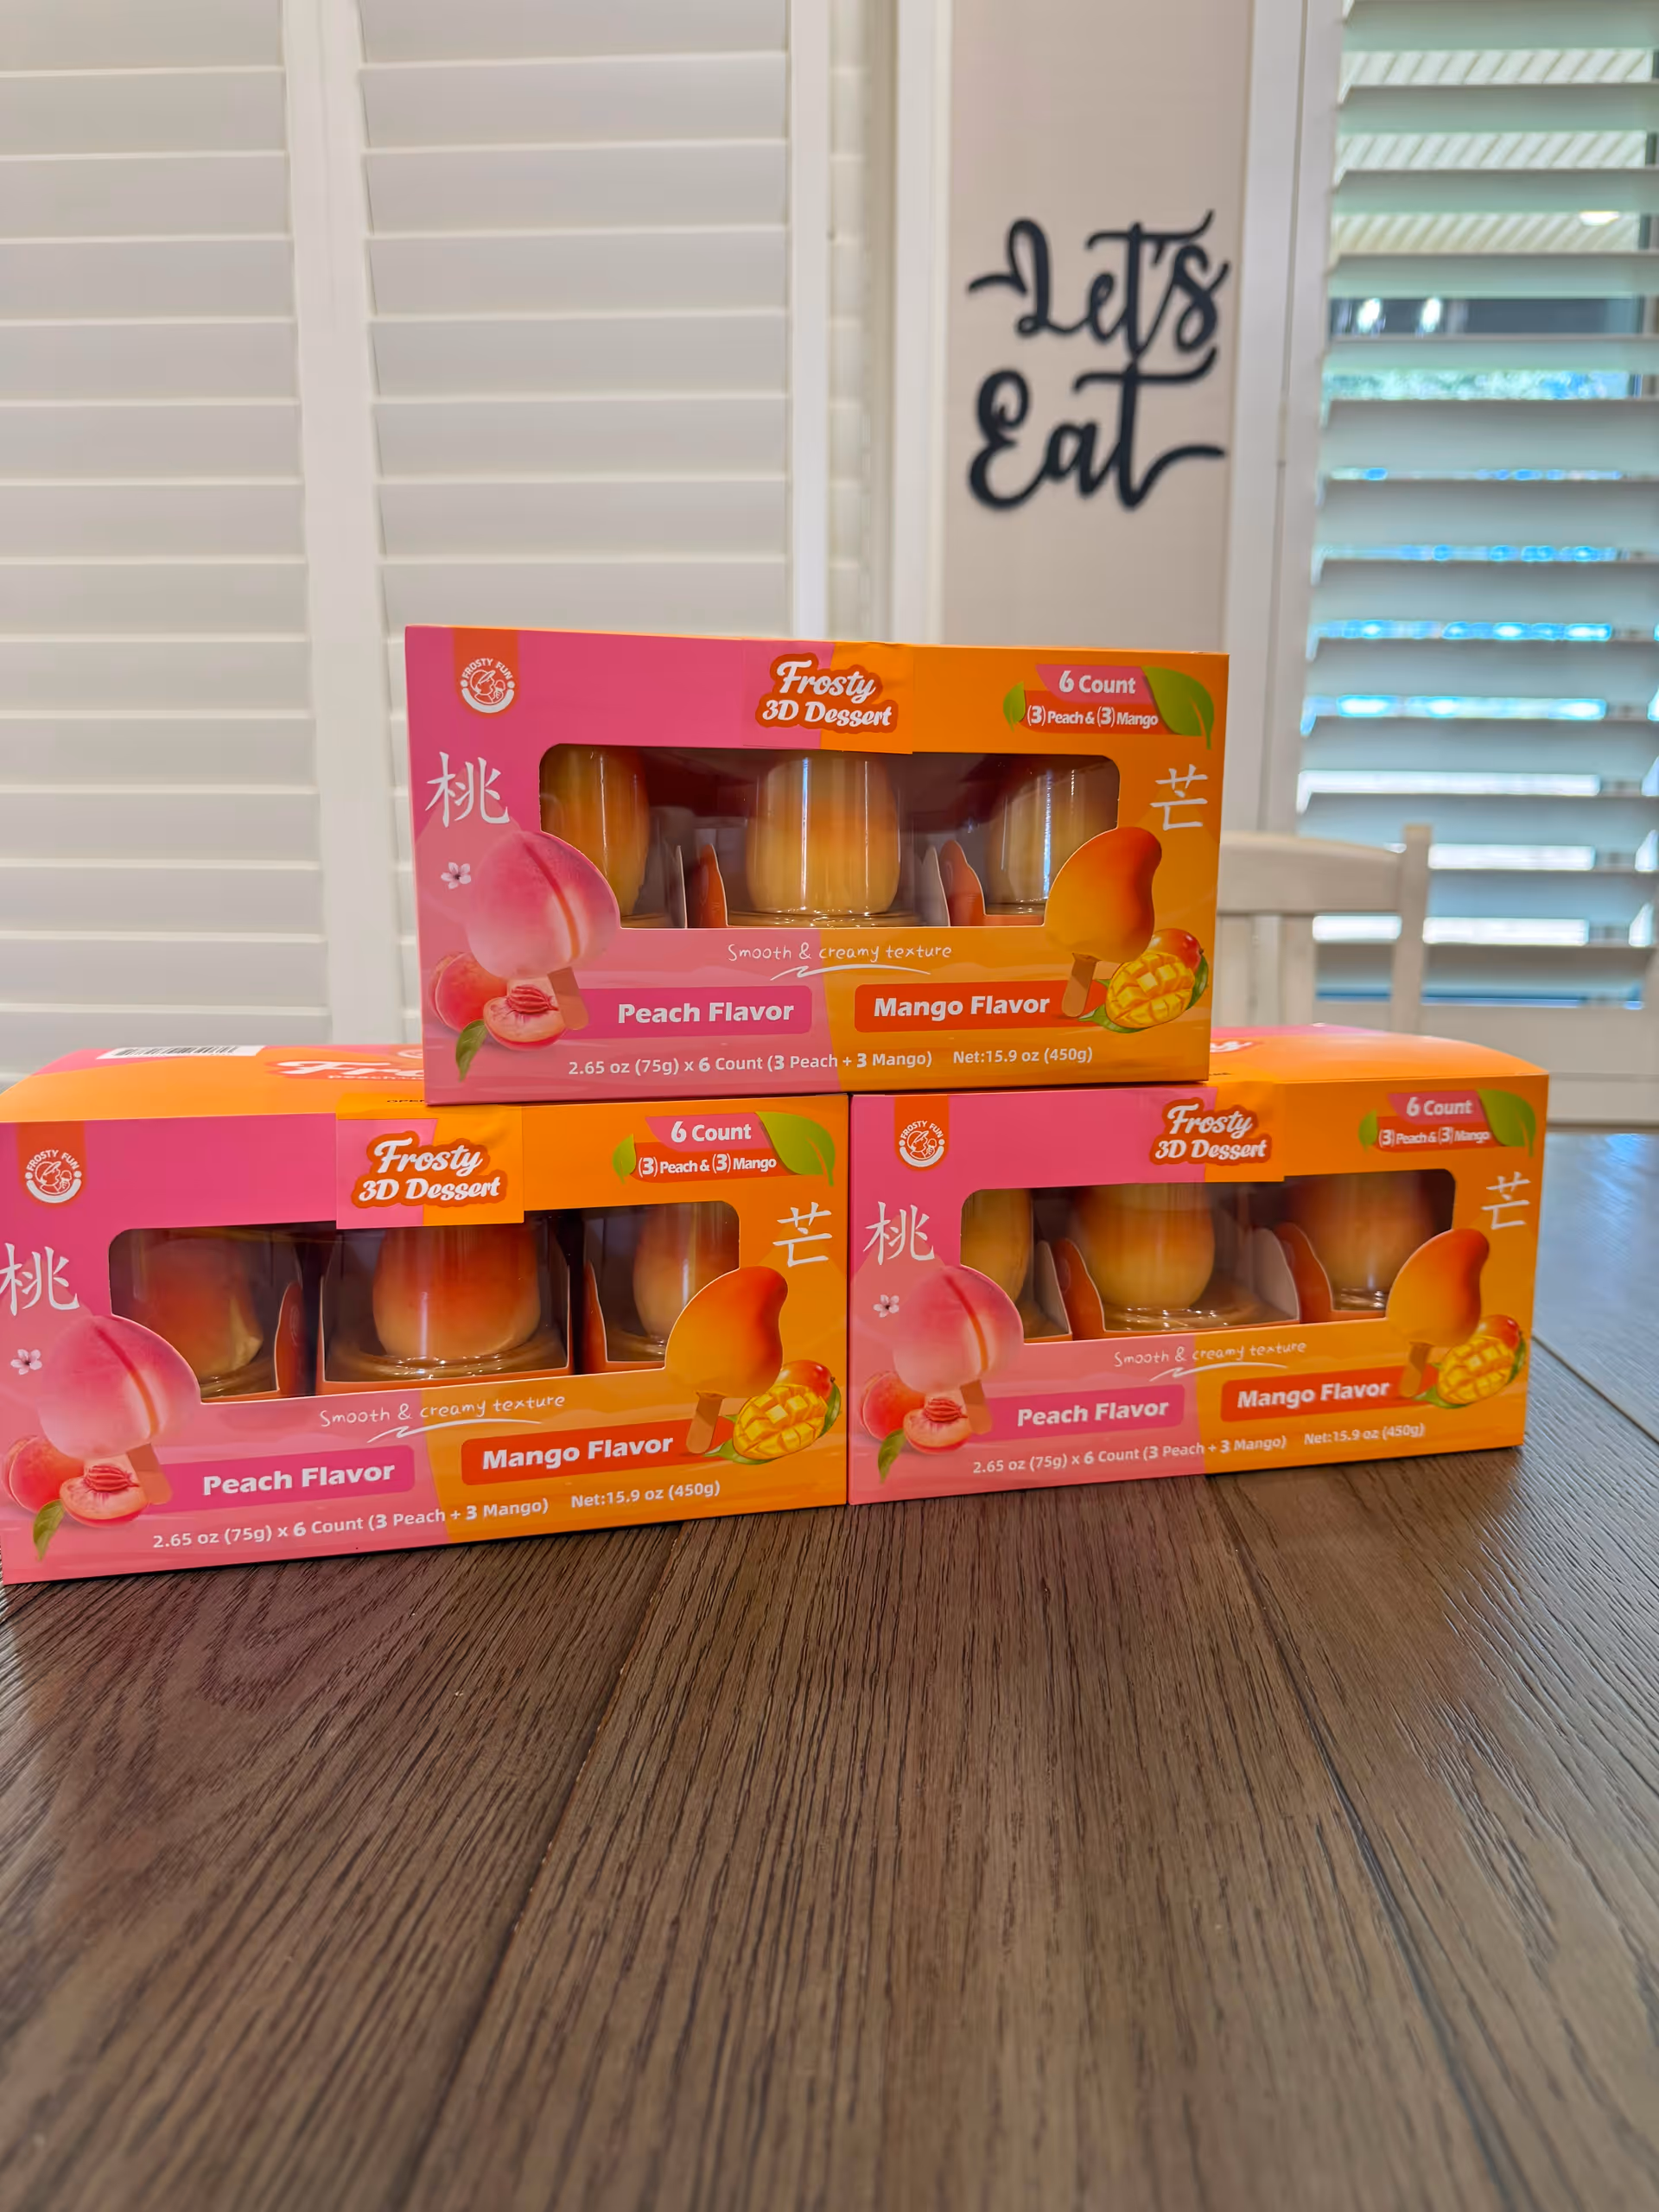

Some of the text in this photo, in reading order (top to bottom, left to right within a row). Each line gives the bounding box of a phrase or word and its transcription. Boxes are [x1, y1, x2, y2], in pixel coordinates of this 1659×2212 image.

[967, 208, 1230, 359] Let's
[967, 346, 1227, 512] Eat
[461, 658, 513, 680] FROSTY FUN
[776, 659, 876, 704] Frosty
[1058, 670, 1136, 694] 6 Count
[762, 699, 893, 728] 3D Dessert
[1027, 705, 1159, 729] (3) Peach & (3) Mango
[424, 752, 510, 828] 桃
[1149, 763, 1209, 831] 芒
[728, 942, 952, 963] Smooth & creamy texture
[618, 1001, 794, 1024] Peach Flavor
[874, 995, 1050, 1021] Mango Flavor
[569, 1052, 932, 1076] 2.65 oz (75g) x 6 Count (3 Peach + 3 Mango)
[953, 1047, 1093, 1064] Net:15.9 oz (450g)
[1406, 1096, 1472, 1116] 6 Count
[671, 1121, 752, 1142] 6 Count
[900, 1120, 944, 1139] FROSTY FUN
[1166, 1103, 1252, 1139] Frosty
[1155, 1139, 1267, 1160] 3D Dessert
[1379, 1127, 1491, 1147] (3) Peach & (3) Mango
[26, 1149, 79, 1172] FROSTY FUN
[374, 1137, 483, 1177] Frosty
[638, 1154, 777, 1178] (3) Peach & (3) Mango
[359, 1176, 500, 1201] 3D Dessert
[1481, 1172, 1530, 1229] 芒
[772, 1202, 832, 1267] 芒
[864, 1201, 934, 1265] 桃
[0, 1243, 80, 1317] 桃
[1114, 1342, 1306, 1367] Smooth & creamy texture
[1237, 1382, 1389, 1409] Mango Flavor
[319, 1395, 565, 1427] Smooth & creamy texture
[1018, 1402, 1169, 1427] Peach Flavor
[1304, 1423, 1425, 1445] Net:15.9 oz (450g)
[483, 1438, 673, 1470] Mango Flavor
[973, 1435, 1287, 1474] 2.65 oz (75g) x 6 Count (3 Peach + 3 Mango)
[203, 1465, 395, 1496] Peach Flavor
[571, 1480, 720, 1508] Net:15.9 oz (450g)
[153, 1497, 549, 1548] 2.65 oz (75g) x 6 Count (3 Peach + 3 Mango)
